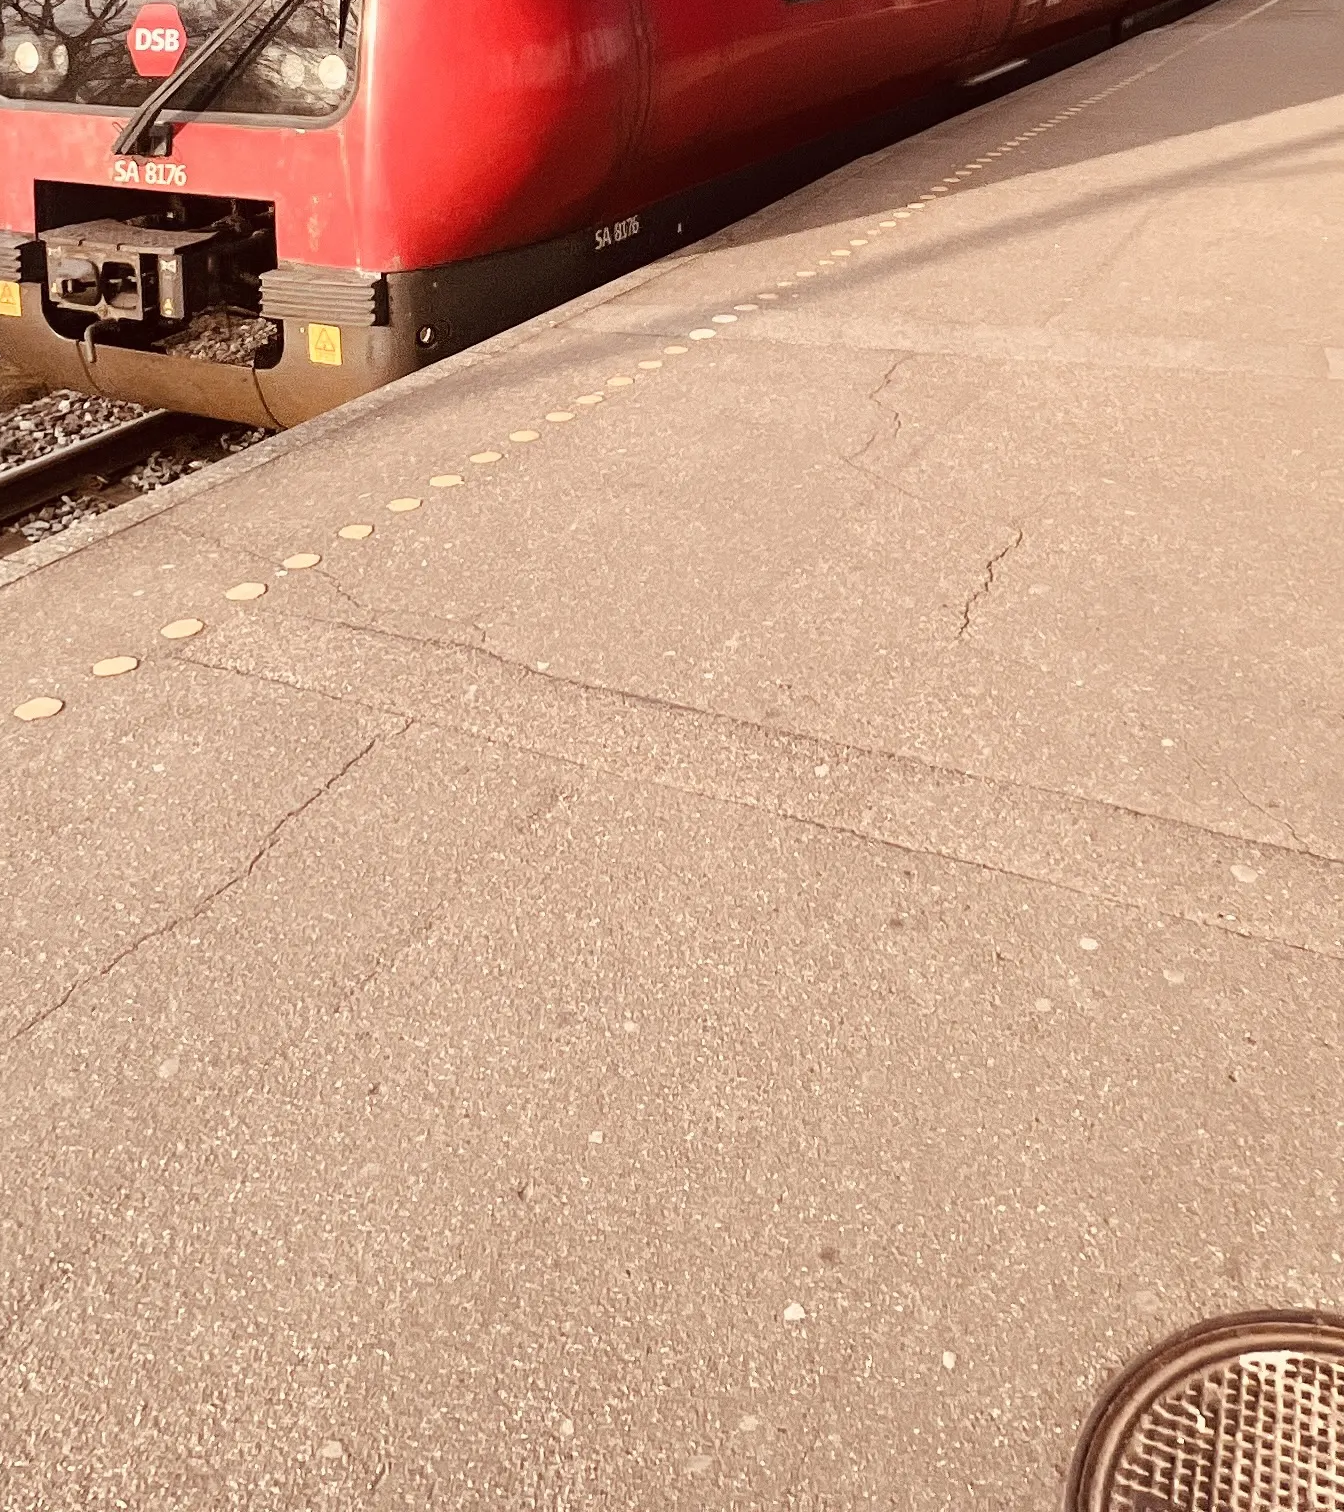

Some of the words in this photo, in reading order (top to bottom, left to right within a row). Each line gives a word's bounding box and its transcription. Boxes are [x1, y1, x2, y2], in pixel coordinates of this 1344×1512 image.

[135, 28, 180, 52] DSB
[114, 160, 139, 183] SA
[145, 163, 187, 186] 8176
[595, 226, 612, 250] SA
[614, 215, 640, 242] 8176
